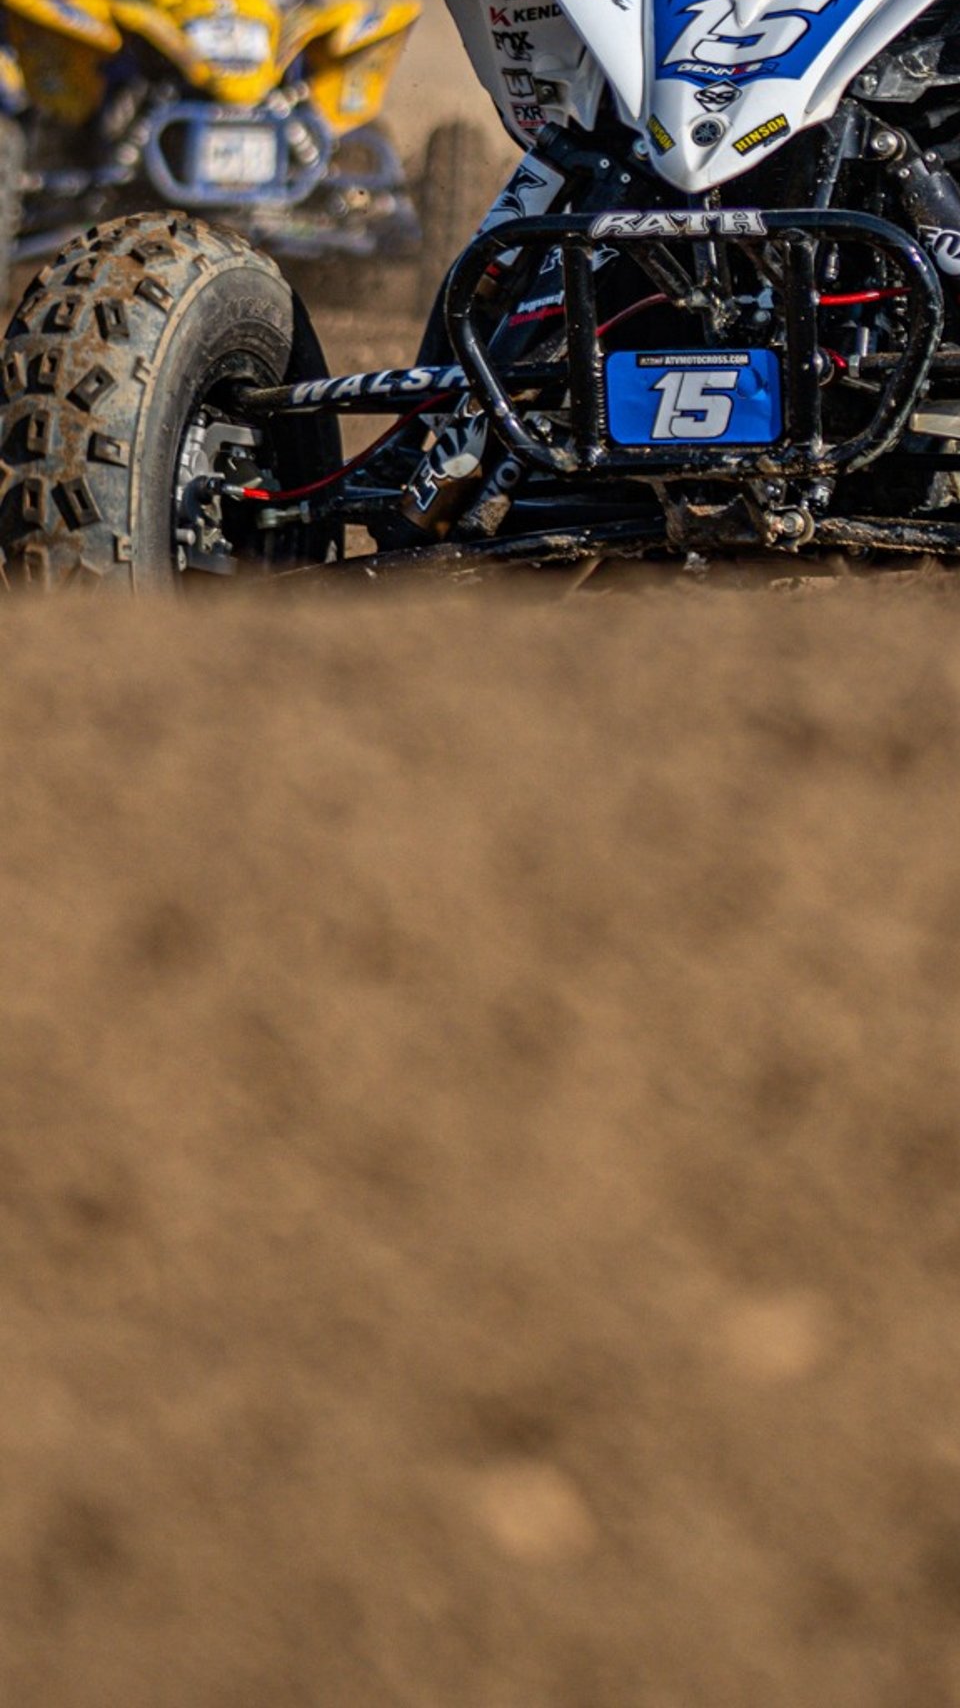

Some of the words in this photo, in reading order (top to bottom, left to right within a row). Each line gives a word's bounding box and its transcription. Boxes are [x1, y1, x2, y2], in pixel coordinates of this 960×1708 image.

[514, 4, 562, 23] KEND
[513, 104, 544, 120] FXR
[734, 115, 787, 152] HINSON
[592, 211, 767, 238] RATH
[649, 370, 740, 441] 15
